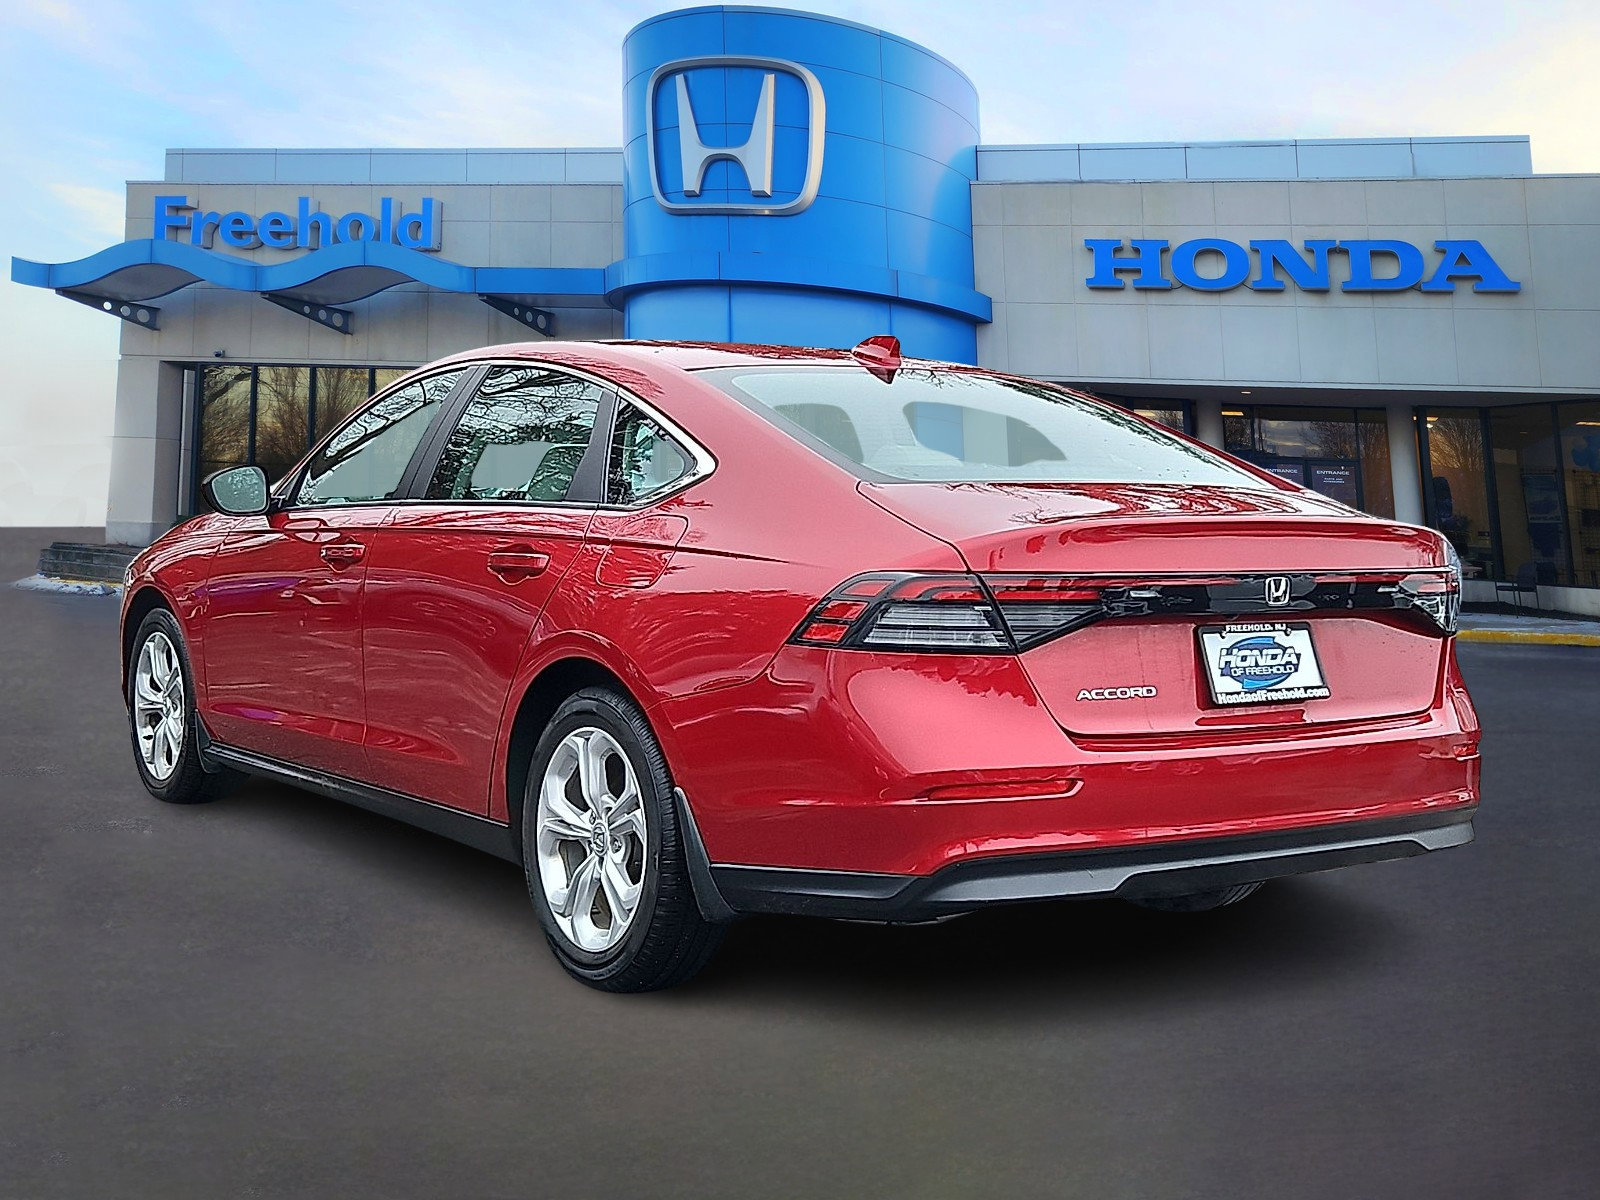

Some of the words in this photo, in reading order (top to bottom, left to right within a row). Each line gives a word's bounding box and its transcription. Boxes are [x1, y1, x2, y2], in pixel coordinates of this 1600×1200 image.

[154, 195, 440, 249] Freehold
[1084, 238, 1521, 293] HONDA
[1275, 623, 1287, 631] NJ
[1219, 646, 1299, 669] HONDA
[1231, 667, 1245, 677] OF
[1245, 664, 1295, 676] FREEHOLD
[1076, 685, 1157, 701] ACCORD
[1217, 688, 1330, 704] HondaofFreehold.com
